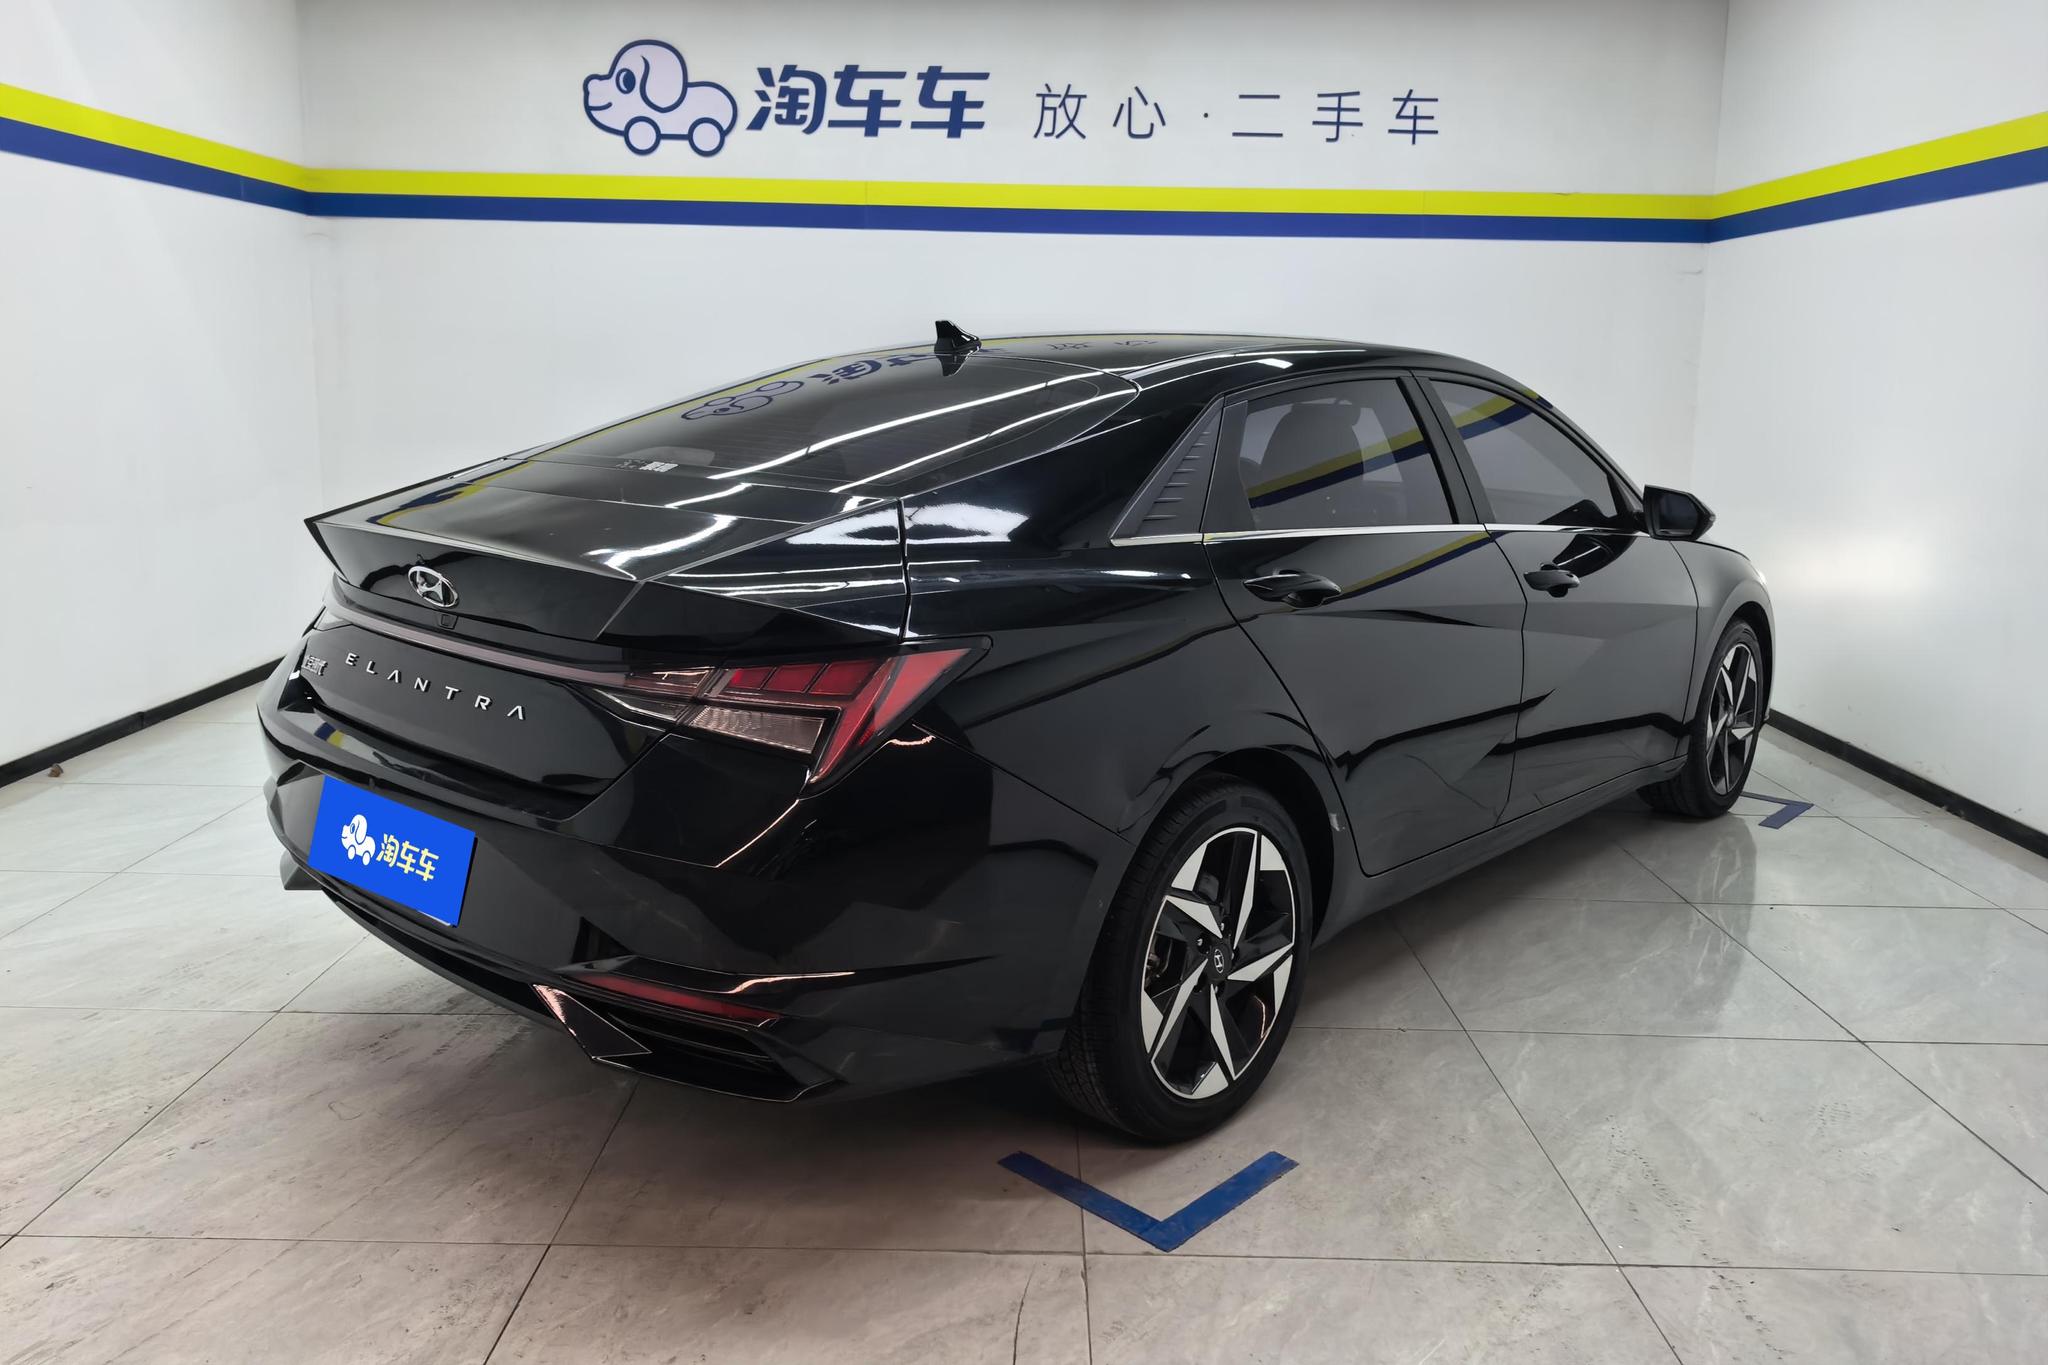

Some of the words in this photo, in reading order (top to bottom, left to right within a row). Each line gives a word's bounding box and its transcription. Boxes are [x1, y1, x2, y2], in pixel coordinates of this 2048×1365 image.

[746, 64, 990, 139] 淘车车
[345, 652, 526, 721] ELANTRA
